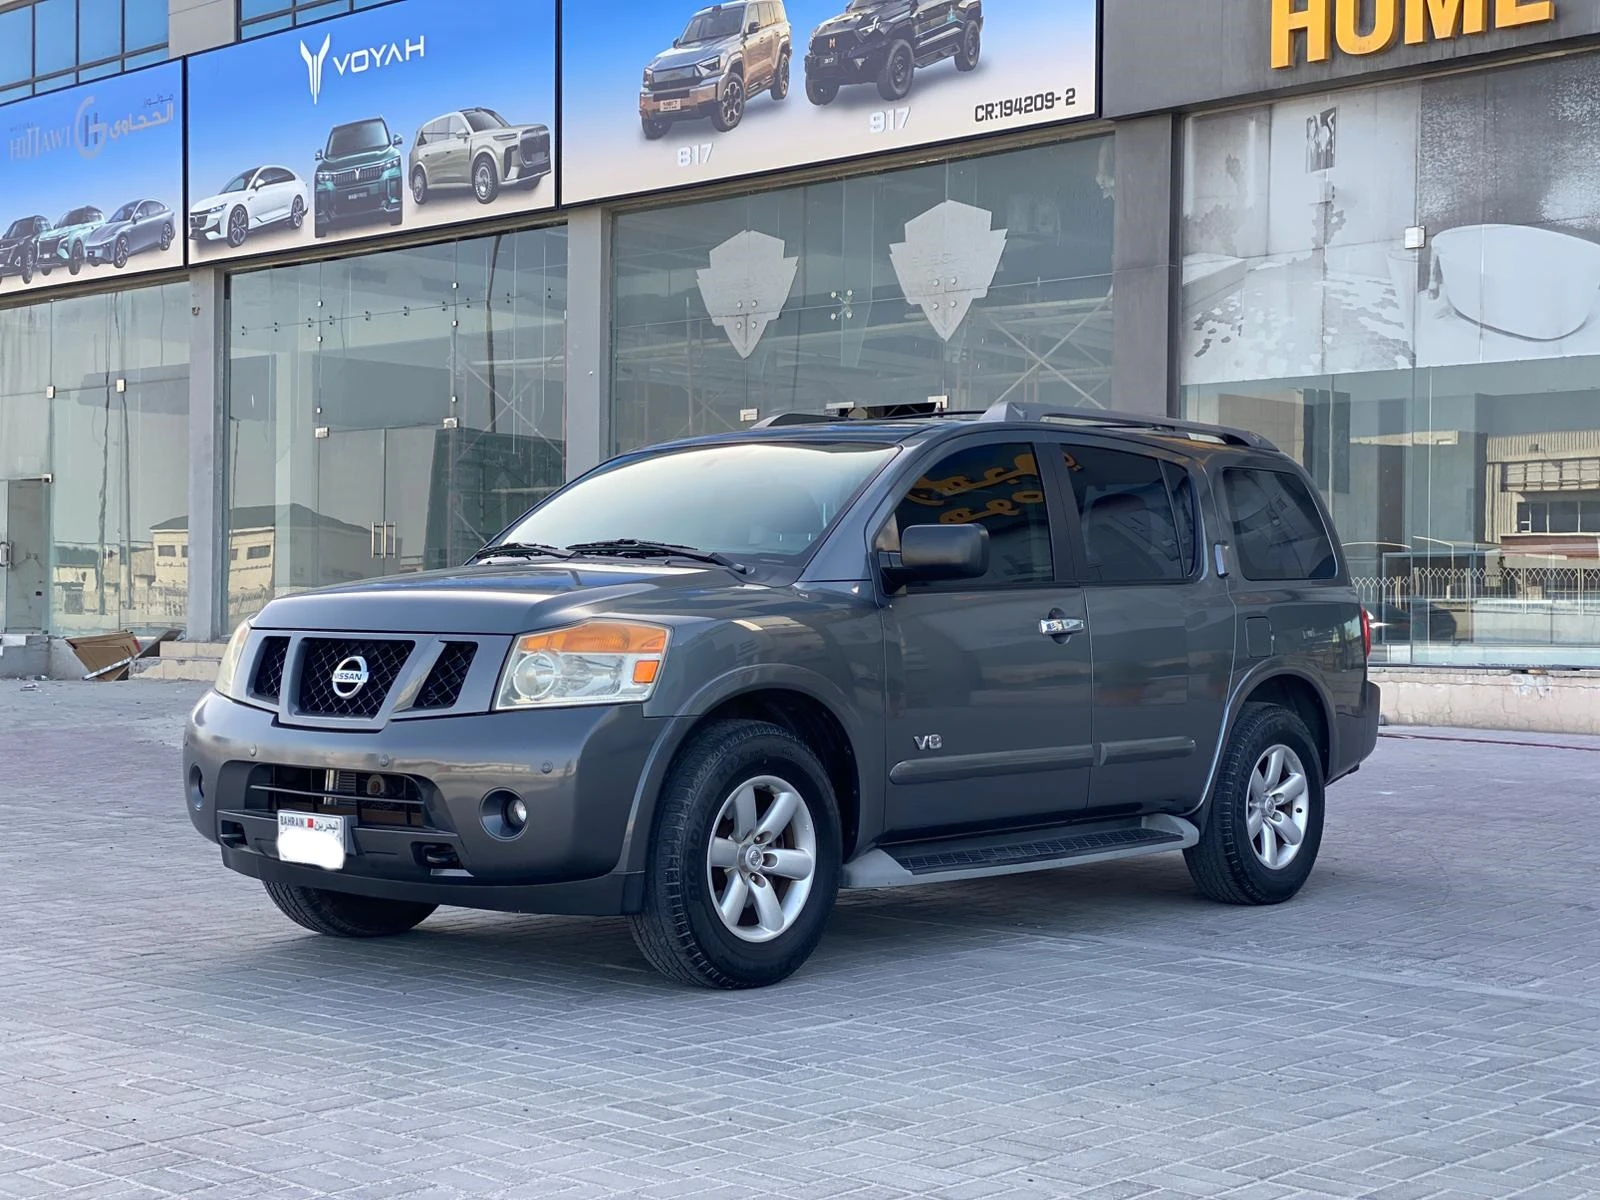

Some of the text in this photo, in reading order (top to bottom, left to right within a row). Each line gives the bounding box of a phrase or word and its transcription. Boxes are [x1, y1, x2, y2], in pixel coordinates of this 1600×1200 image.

[332, 35, 425, 76] VOYAH
[974, 87, 1076, 122] CR:194209- 2
[869, 107, 911, 134] 917
[677, 143, 713, 167] 817
[280, 815, 305, 828] BAHRAIN
